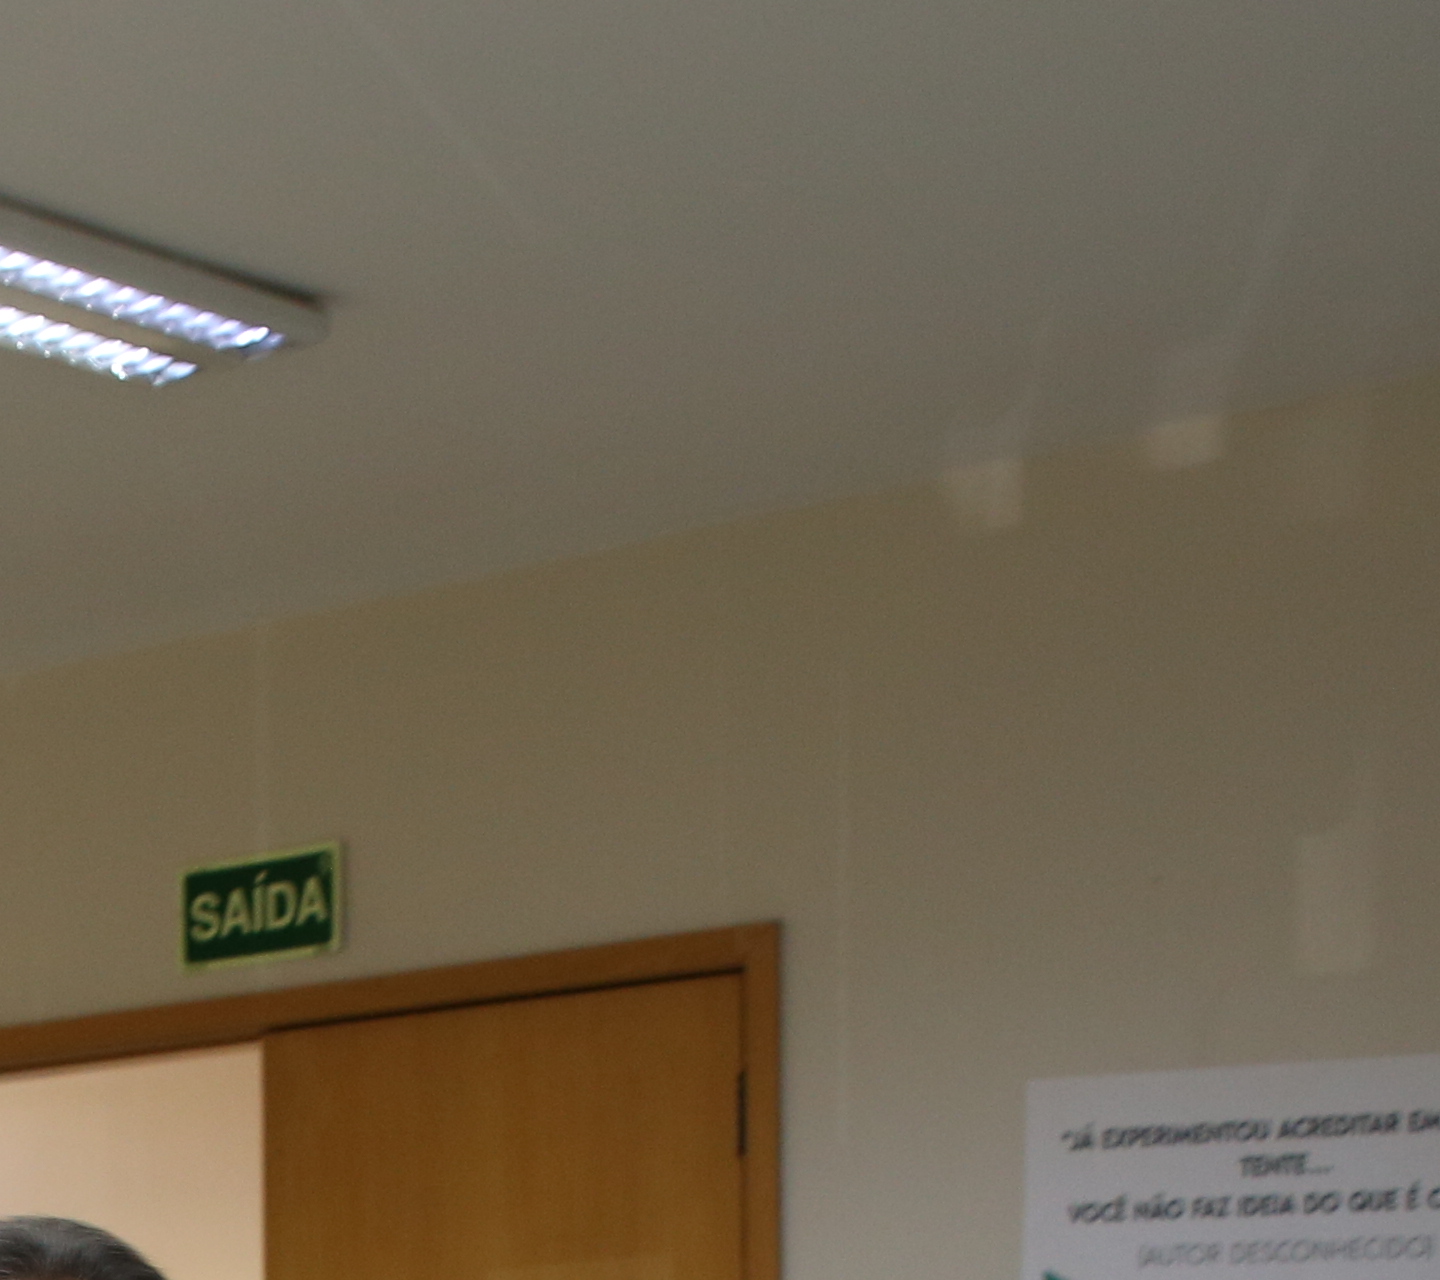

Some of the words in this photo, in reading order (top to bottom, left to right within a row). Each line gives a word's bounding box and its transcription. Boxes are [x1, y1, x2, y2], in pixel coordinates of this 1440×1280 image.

[190, 869, 327, 942] SAÍDA
[1101, 1120, 1271, 1150] EXPERIMENTOU
[1277, 1112, 1399, 1140] ACREDITAR
[1068, 1193, 1127, 1225] VOCÊ
[1133, 1191, 1186, 1221] NÃO
[1191, 1195, 1231, 1219] FAZ
[1237, 1193, 1296, 1217] IDEIA
[1303, 1190, 1340, 1215] DO
[1347, 1187, 1401, 1212] QUE
[1406, 1180, 1422, 1210] É
[1137, 1241, 1222, 1268] (AUTOR
[1229, 1234, 1433, 1266] DESCONHECIDO)
